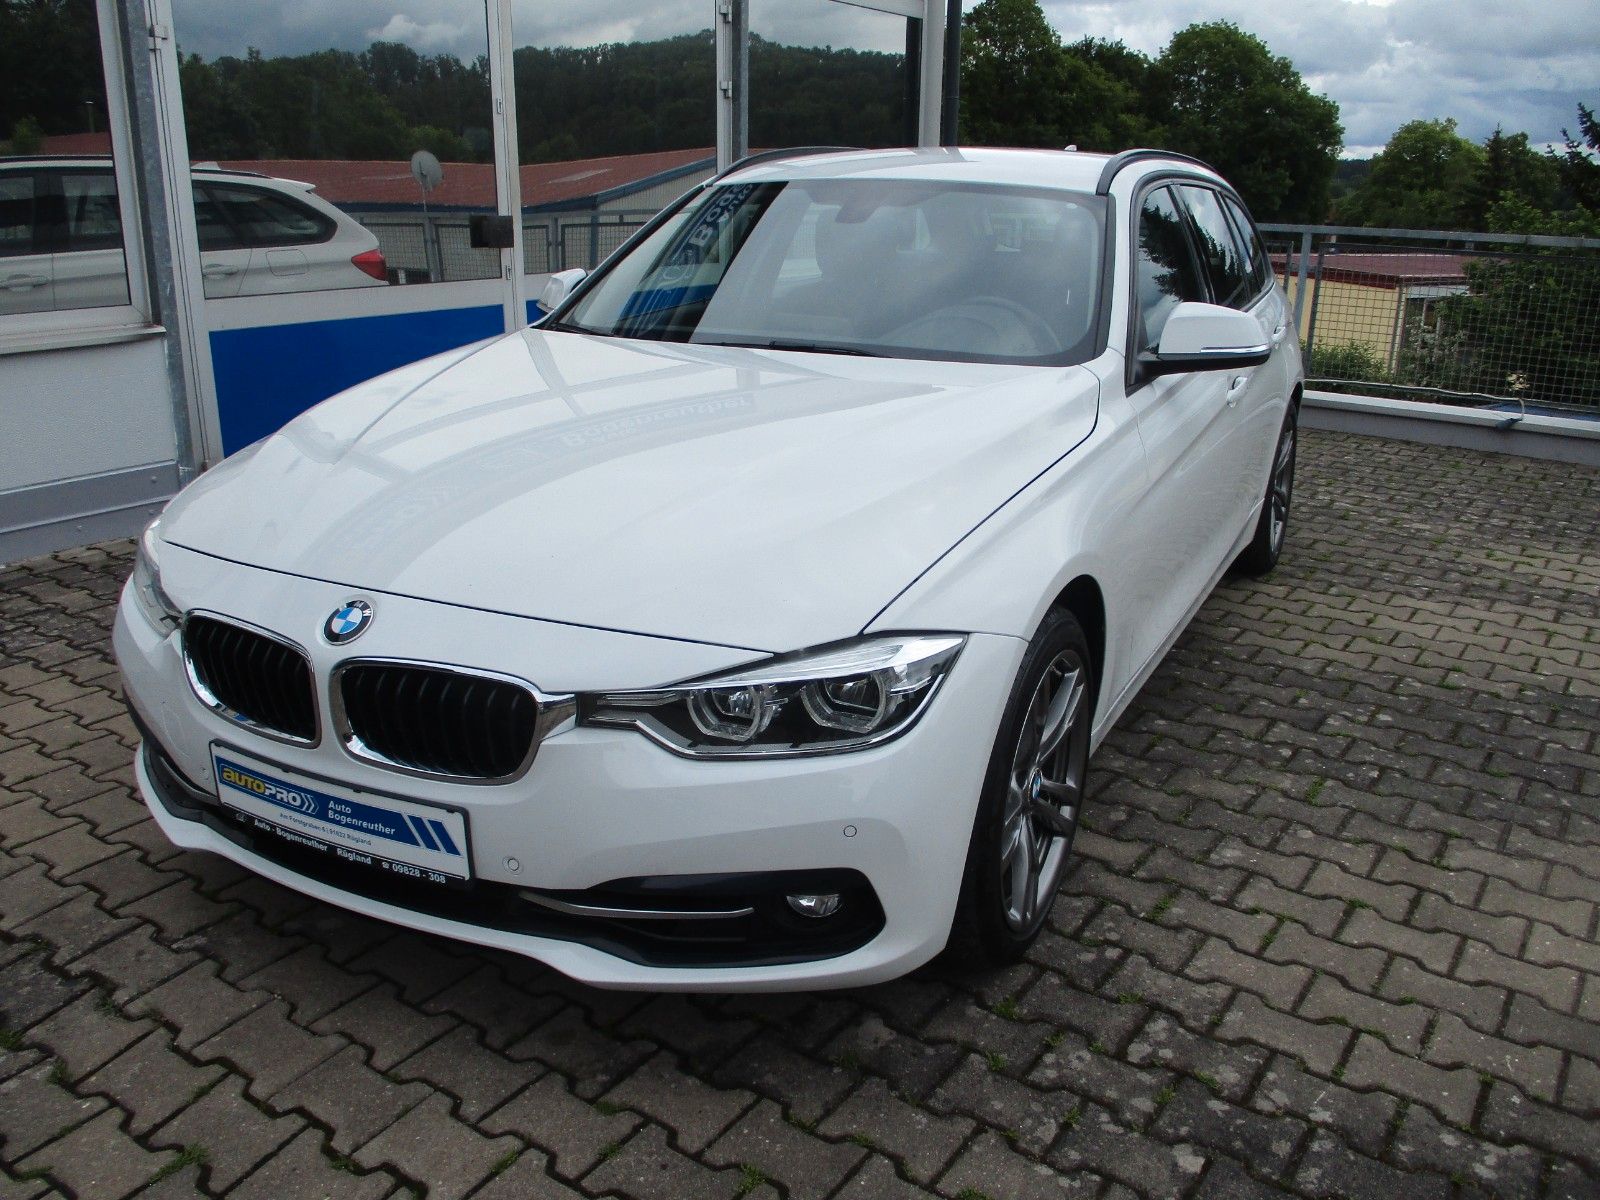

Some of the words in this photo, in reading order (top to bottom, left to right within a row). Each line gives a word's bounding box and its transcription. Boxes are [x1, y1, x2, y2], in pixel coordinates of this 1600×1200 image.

[328, 800, 352, 814] Auto
[328, 810, 396, 835] Bogenreuther
[346, 833, 372, 846] Rügland
[254, 819, 270, 831] Auto
[276, 827, 328, 852] Bogenreuther
[336, 848, 372, 865] Rügland
[392, 863, 420, 877] 09828
[428, 872, 446, 884] 308
